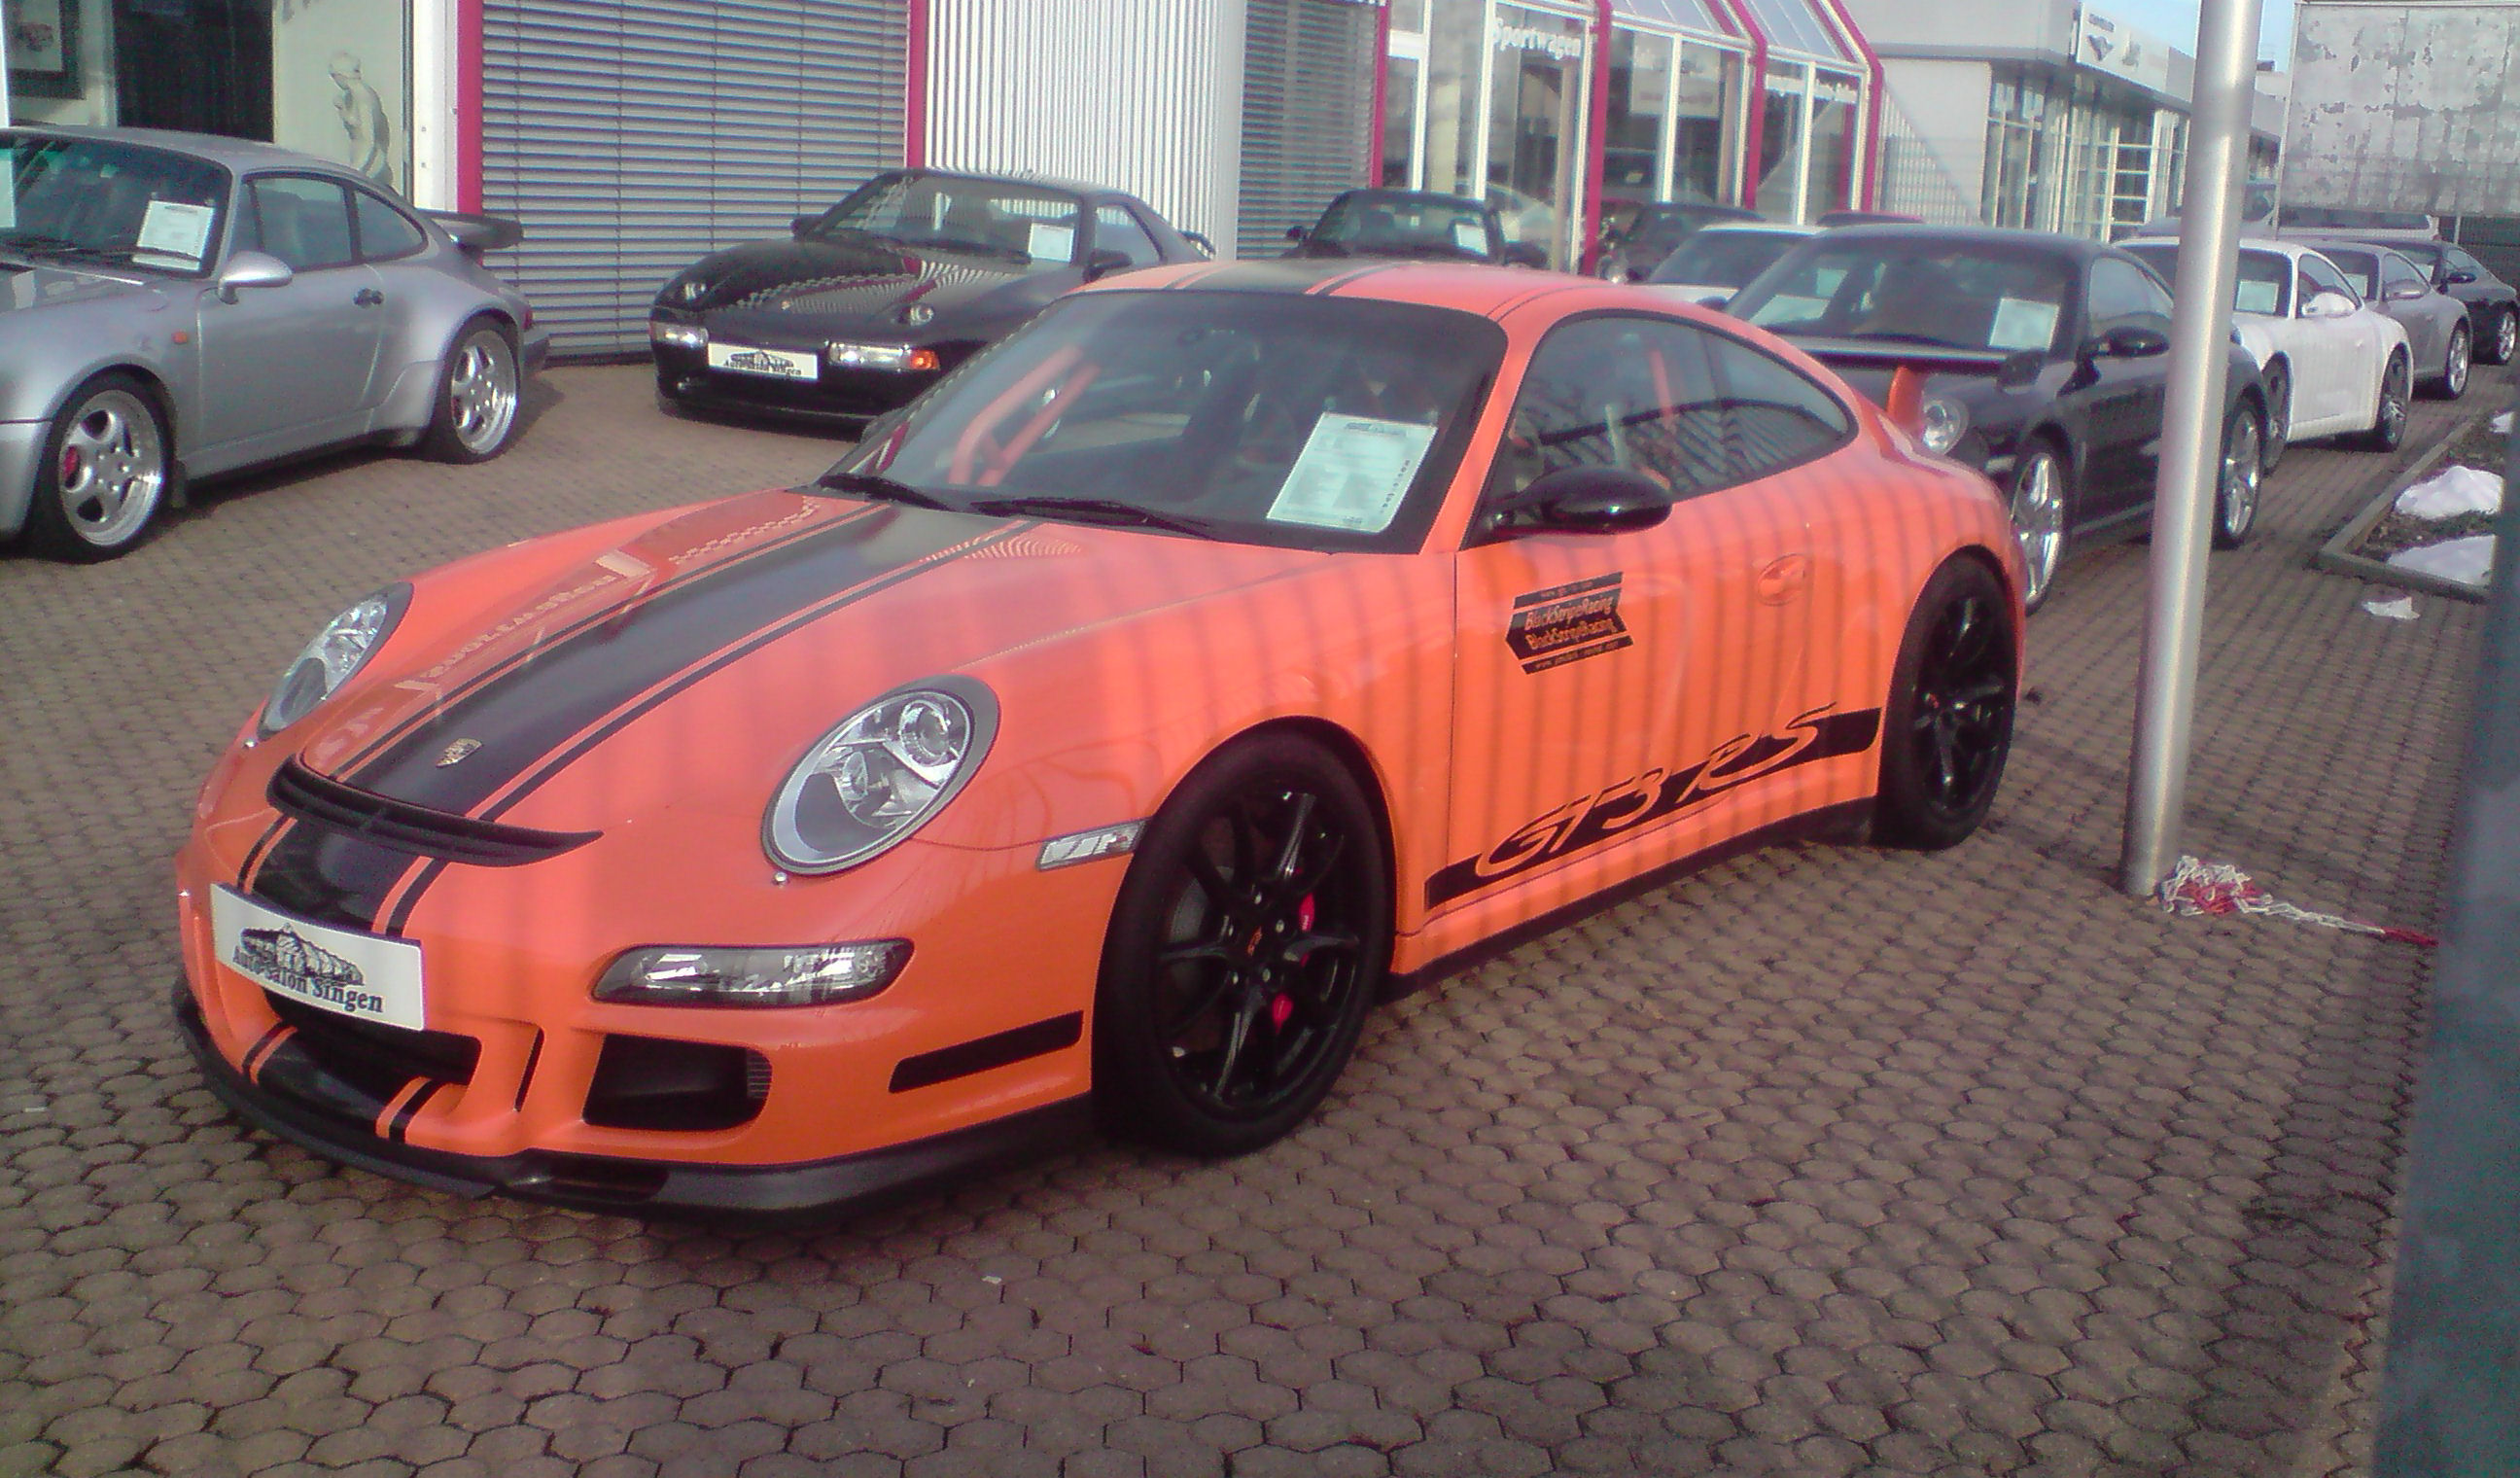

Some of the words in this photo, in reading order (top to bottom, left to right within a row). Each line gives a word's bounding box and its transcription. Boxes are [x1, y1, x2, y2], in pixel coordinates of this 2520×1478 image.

[1476, 766, 1665, 877] GT3
[1677, 701, 1837, 803] RS
[311, 977, 384, 1012] Singen
